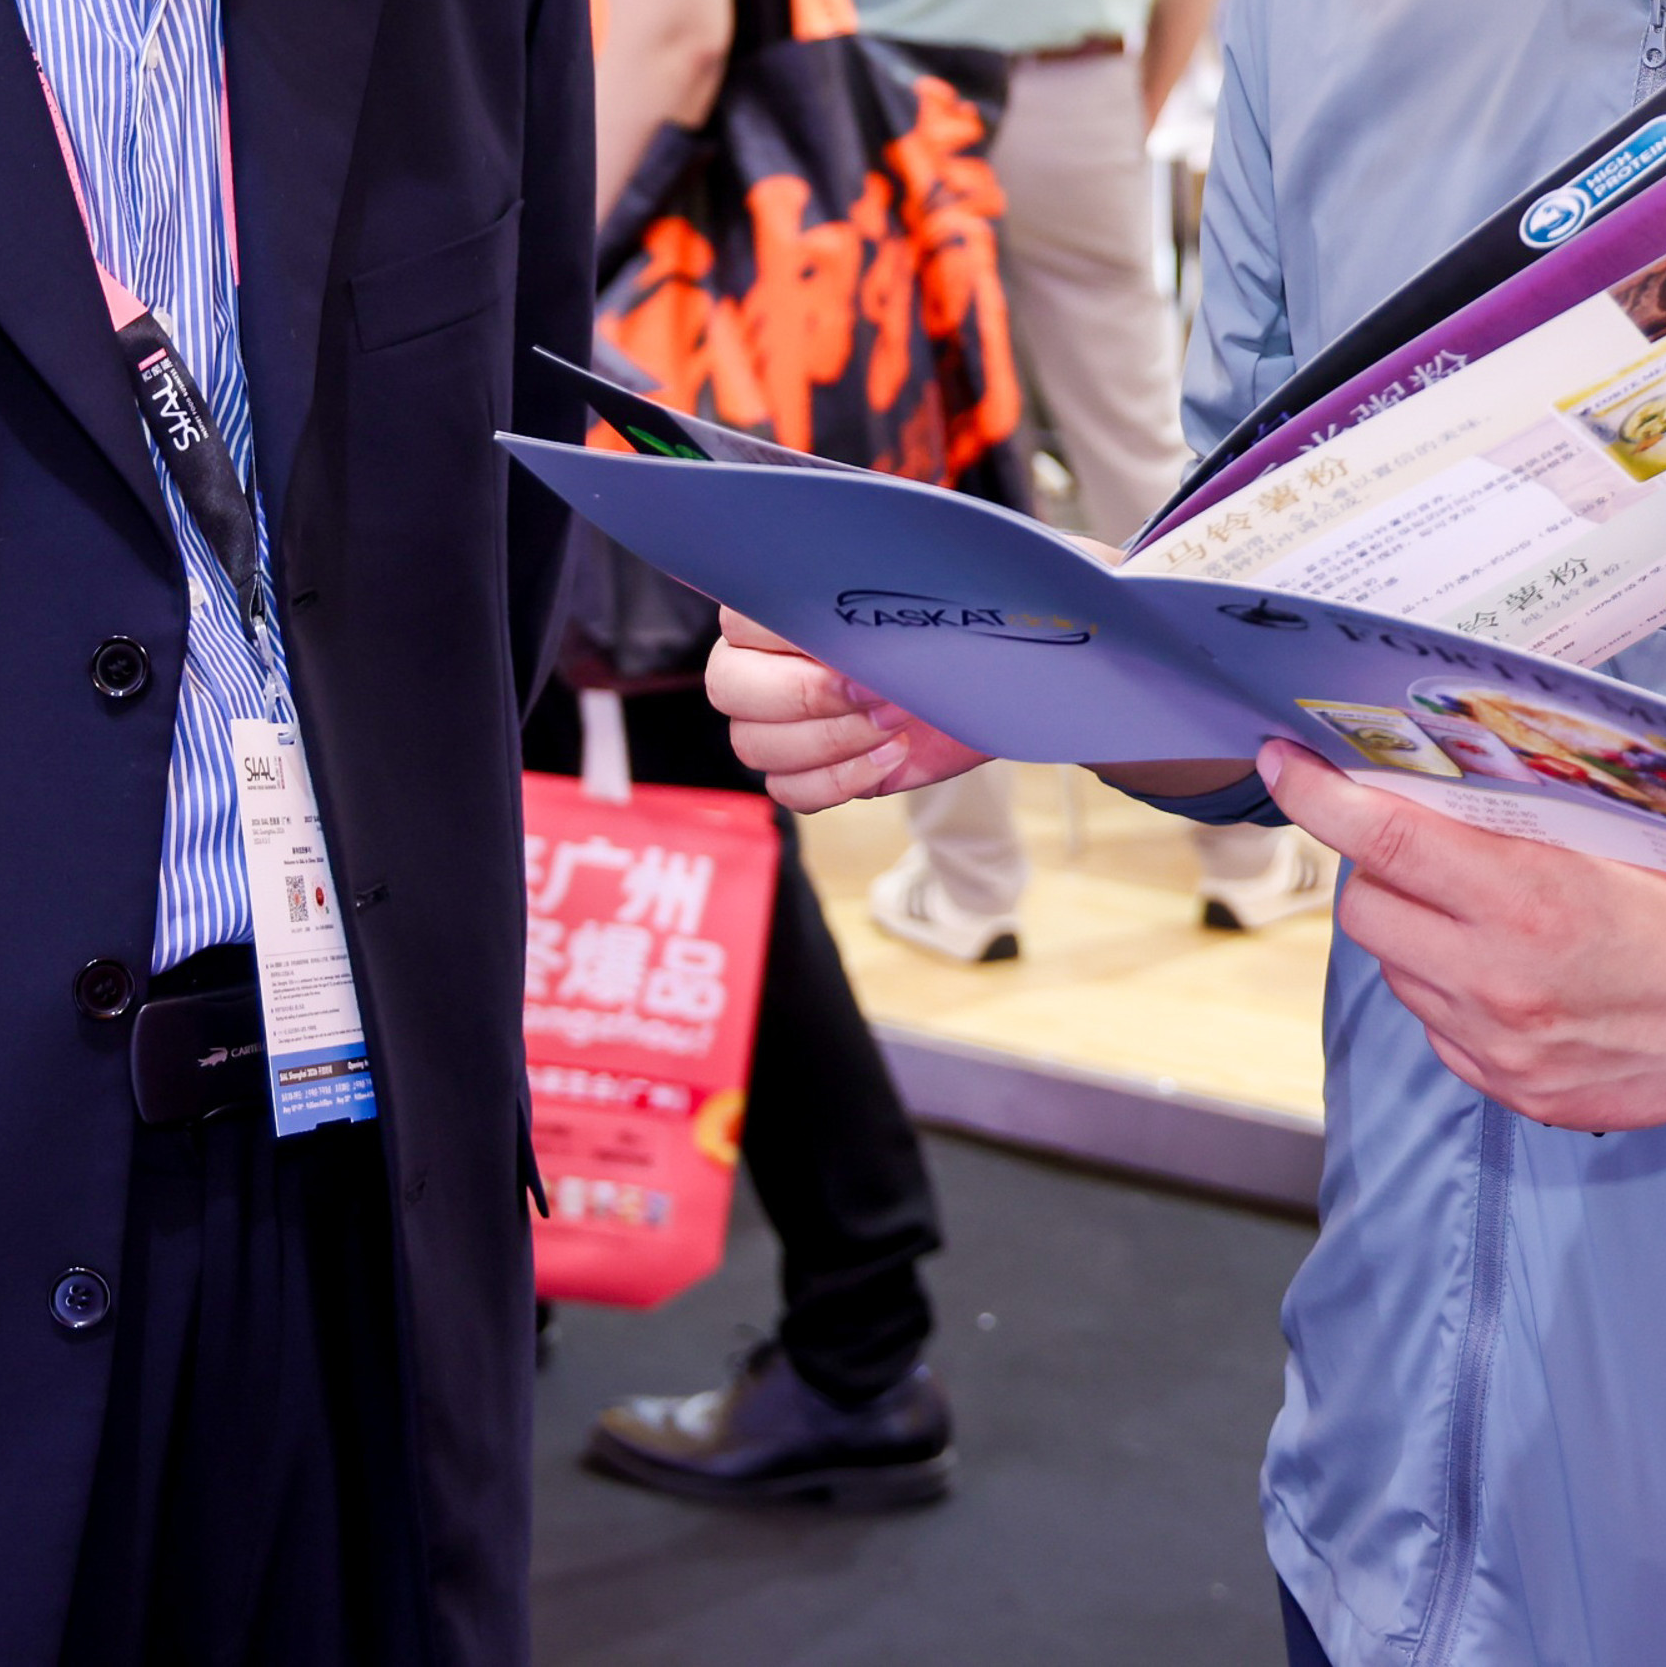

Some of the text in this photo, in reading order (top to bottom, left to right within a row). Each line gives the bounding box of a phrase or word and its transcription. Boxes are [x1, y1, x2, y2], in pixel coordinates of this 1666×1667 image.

[1585, 150, 1633, 189] HIGH
[151, 372, 201, 452] SIAL
[1162, 453, 1350, 574] 马铃薯粉
[834, 608, 1006, 626] KASKAT
[244, 757, 275, 782] SIAL
